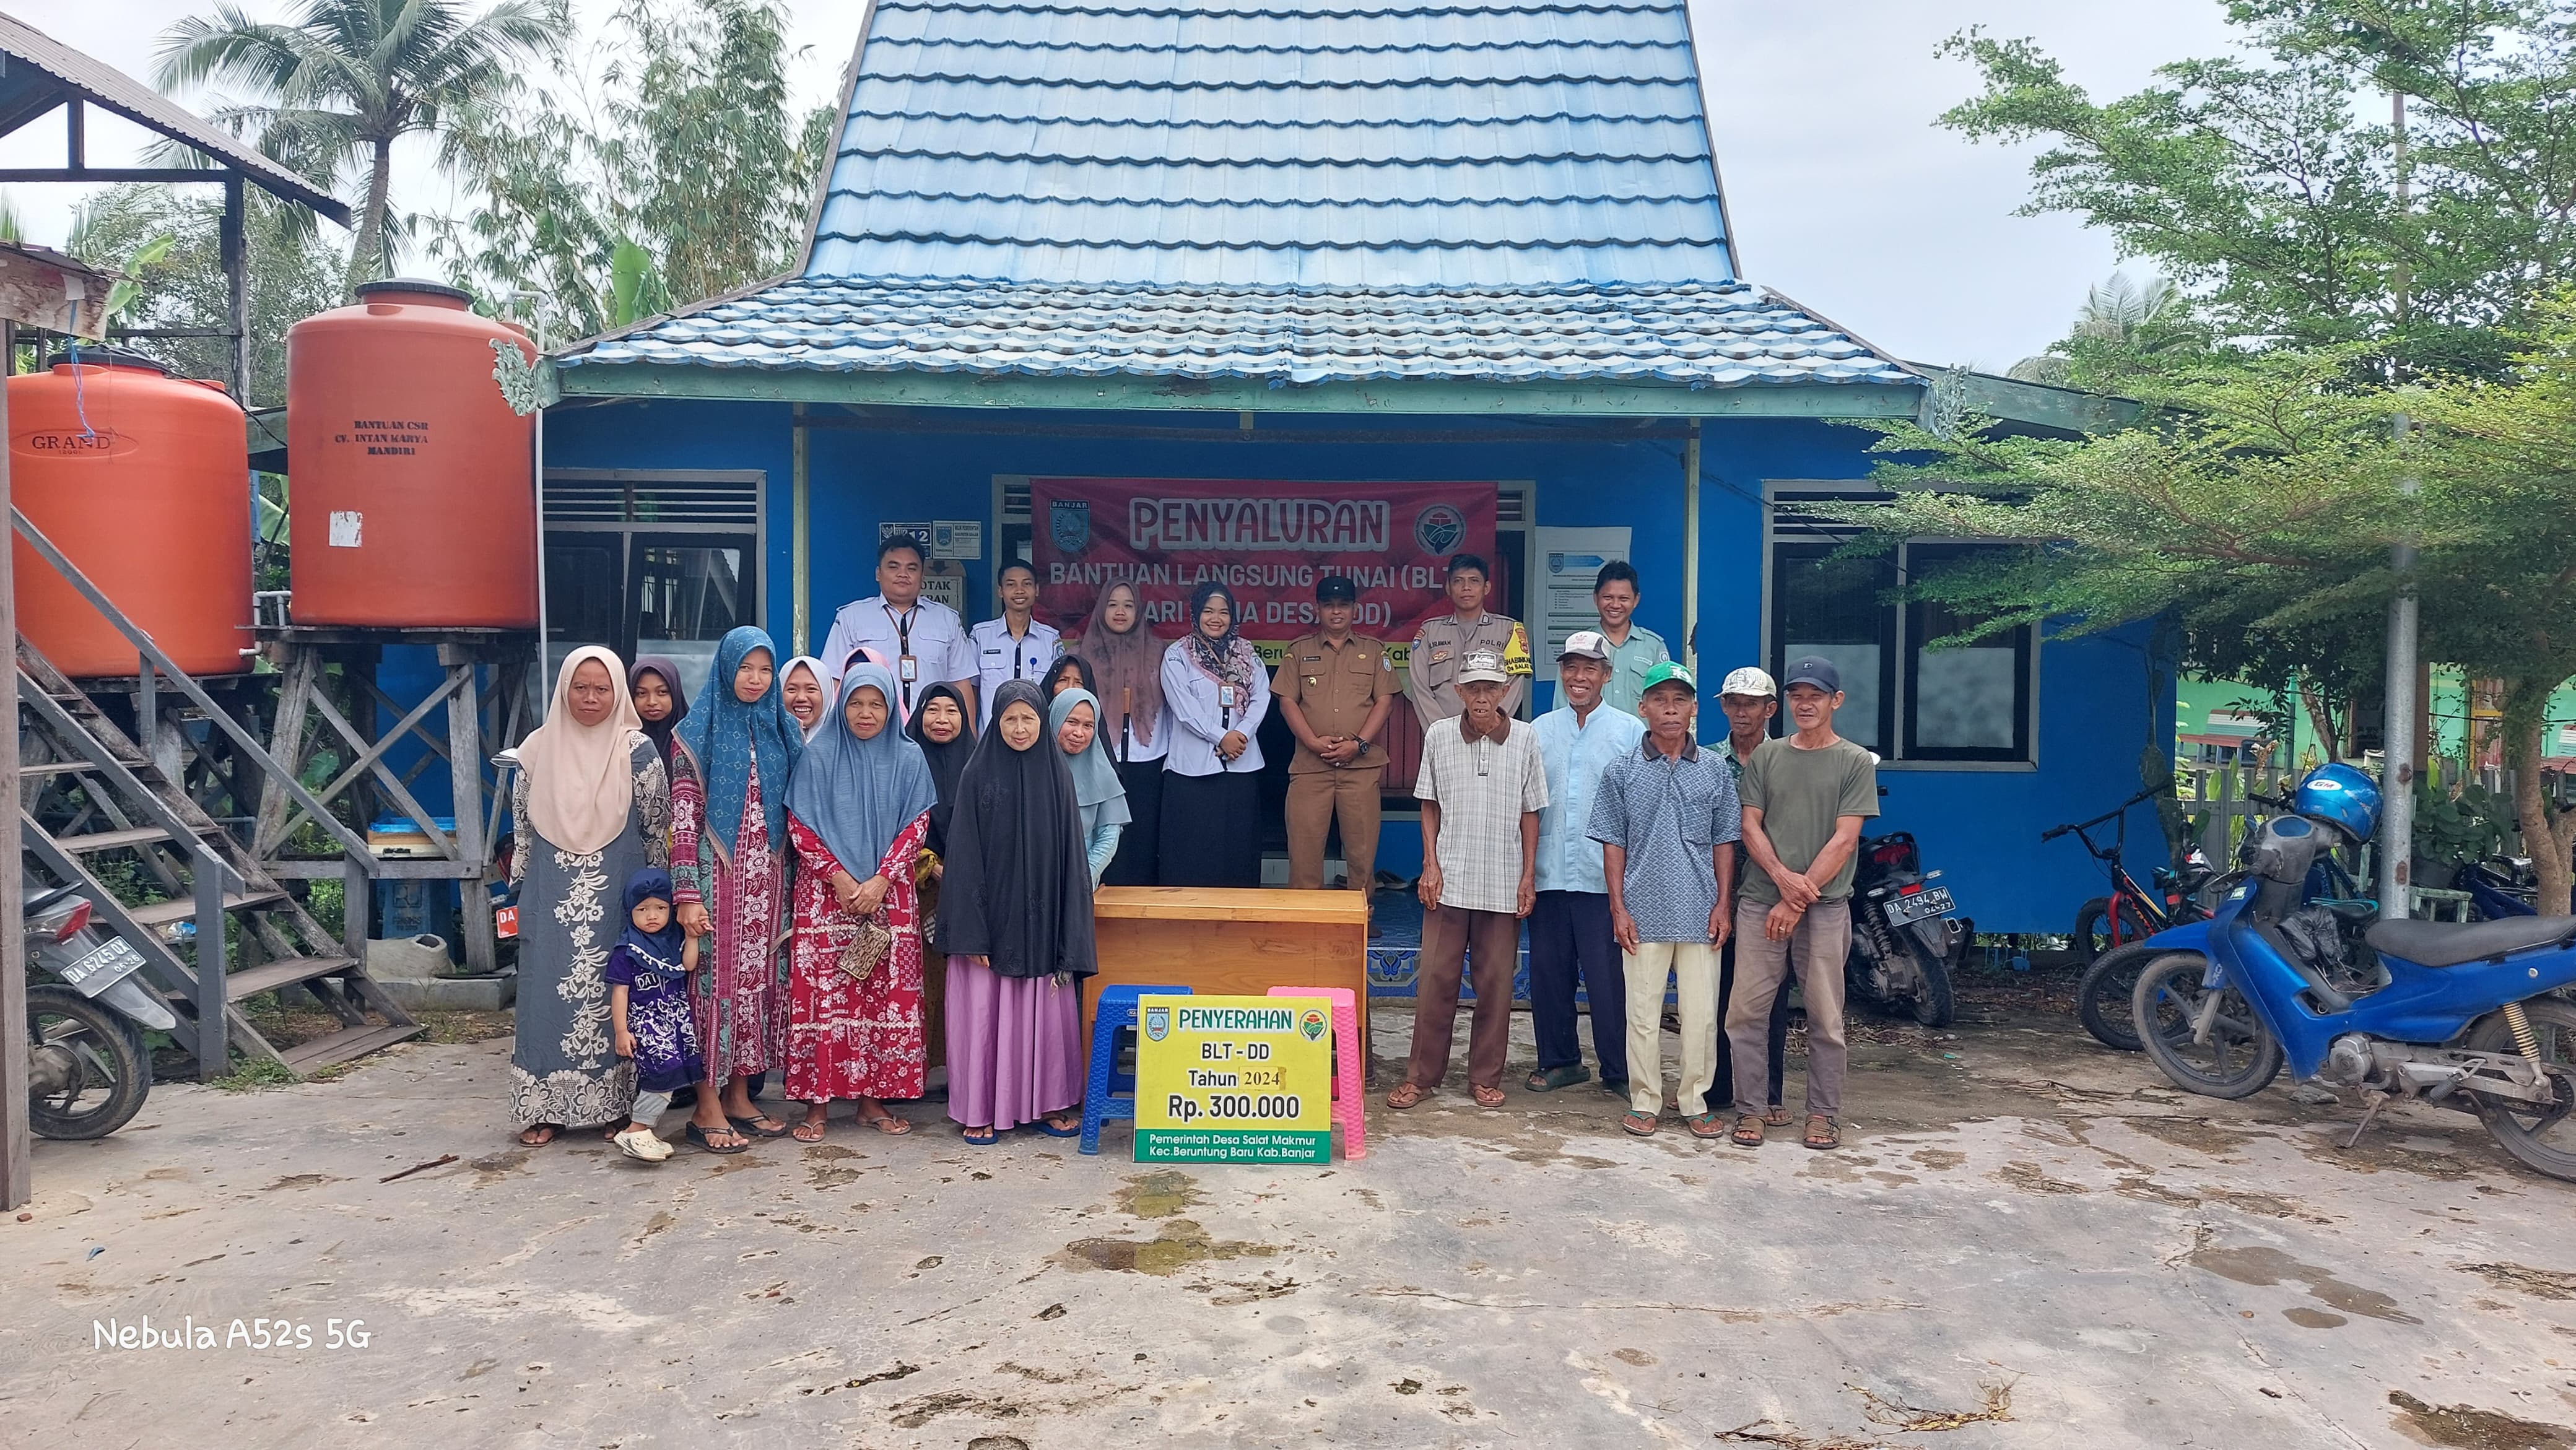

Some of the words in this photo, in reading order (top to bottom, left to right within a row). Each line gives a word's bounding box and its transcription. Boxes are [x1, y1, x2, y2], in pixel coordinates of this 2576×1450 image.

[354, 421, 404, 430] BANTUAN
[407, 422, 429, 430] CSR
[32, 435, 111, 449] GRAND
[355, 434, 387, 443] INTAN
[391, 435, 428, 443] KARYA
[368, 447, 416, 455] MANDIRI
[1133, 501, 1383, 544] PENYALURAN
[1050, 563, 1170, 585] BANTUAN
[1177, 564, 1313, 587] LANGSUNG
[1319, 565, 1395, 588] TUNAI
[1401, 564, 1449, 591] (BL
[922, 581, 951, 591] OTAK
[1145, 601, 1183, 623] ARI
[1266, 602, 1319, 624] DES
[1479, 640, 1504, 648] POLRI
[1886, 902, 1902, 914] DA
[1904, 893, 1930, 909] 2494
[1932, 888, 1948, 901] BW
[499, 910, 516, 923] DA
[66, 966, 89, 983] DA
[83, 948, 116, 972] 6245
[1178, 1009, 1292, 1030] PENYERAHAN
[1201, 1043, 1232, 1059] BLT
[1248, 1043, 1269, 1059] DD
[1188, 1070, 1237, 1087] Tahun
[1244, 1071, 1280, 1085] 2024
[1168, 1095, 1203, 1122] Rp.
[1209, 1095, 1300, 1119] 300.000
[1149, 1134, 1209, 1145] Pemerintah
[1212, 1134, 1240, 1145] Desa
[1242, 1134, 1269, 1145] Salat
[1272, 1135, 1316, 1146] Makmur
[1230, 1147, 1254, 1157] Baru
